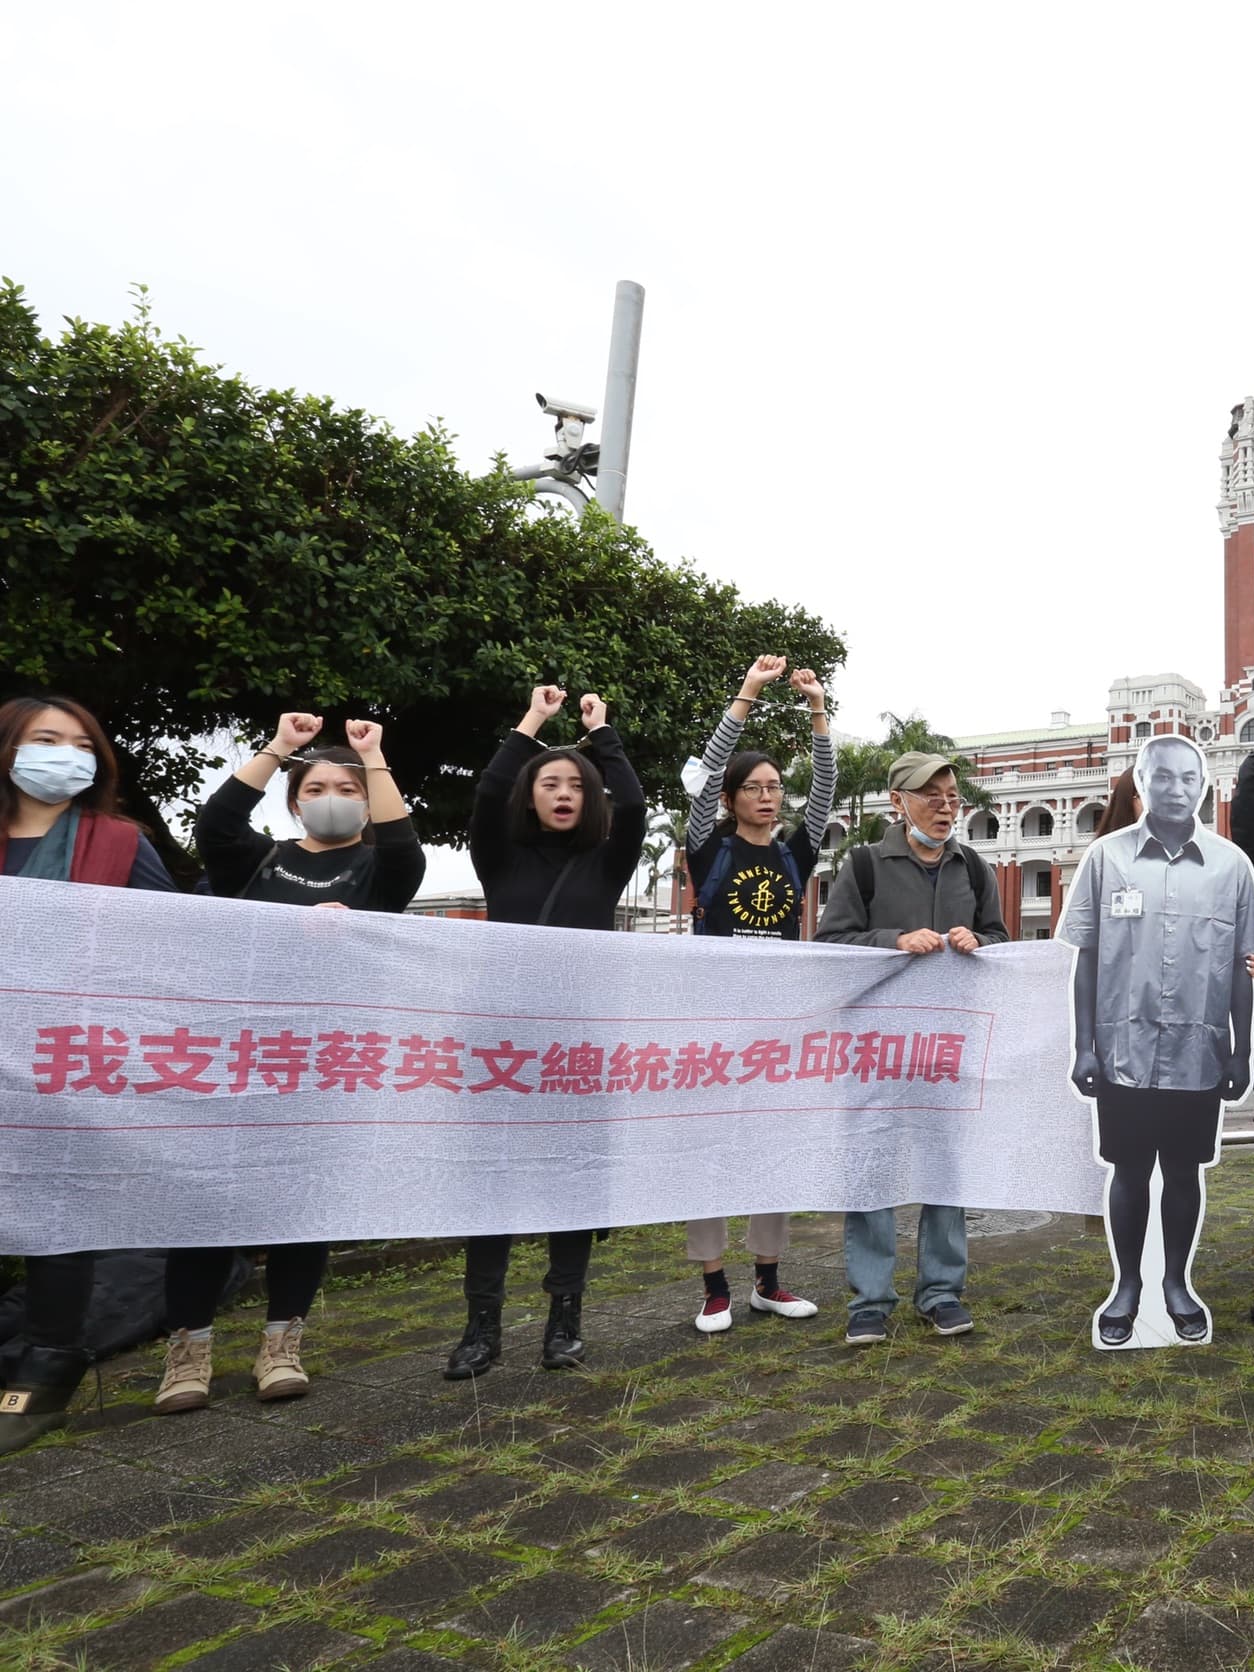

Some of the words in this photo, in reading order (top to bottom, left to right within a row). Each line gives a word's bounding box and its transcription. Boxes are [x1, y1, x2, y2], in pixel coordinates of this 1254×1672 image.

[732, 865, 784, 886] AMNESTY
[727, 883, 795, 927] INTERNATIONAL
[33, 1023, 963, 1097] 我支持蔡英文總統赦免邱和順
[7, 1394, 20, 1407] B
